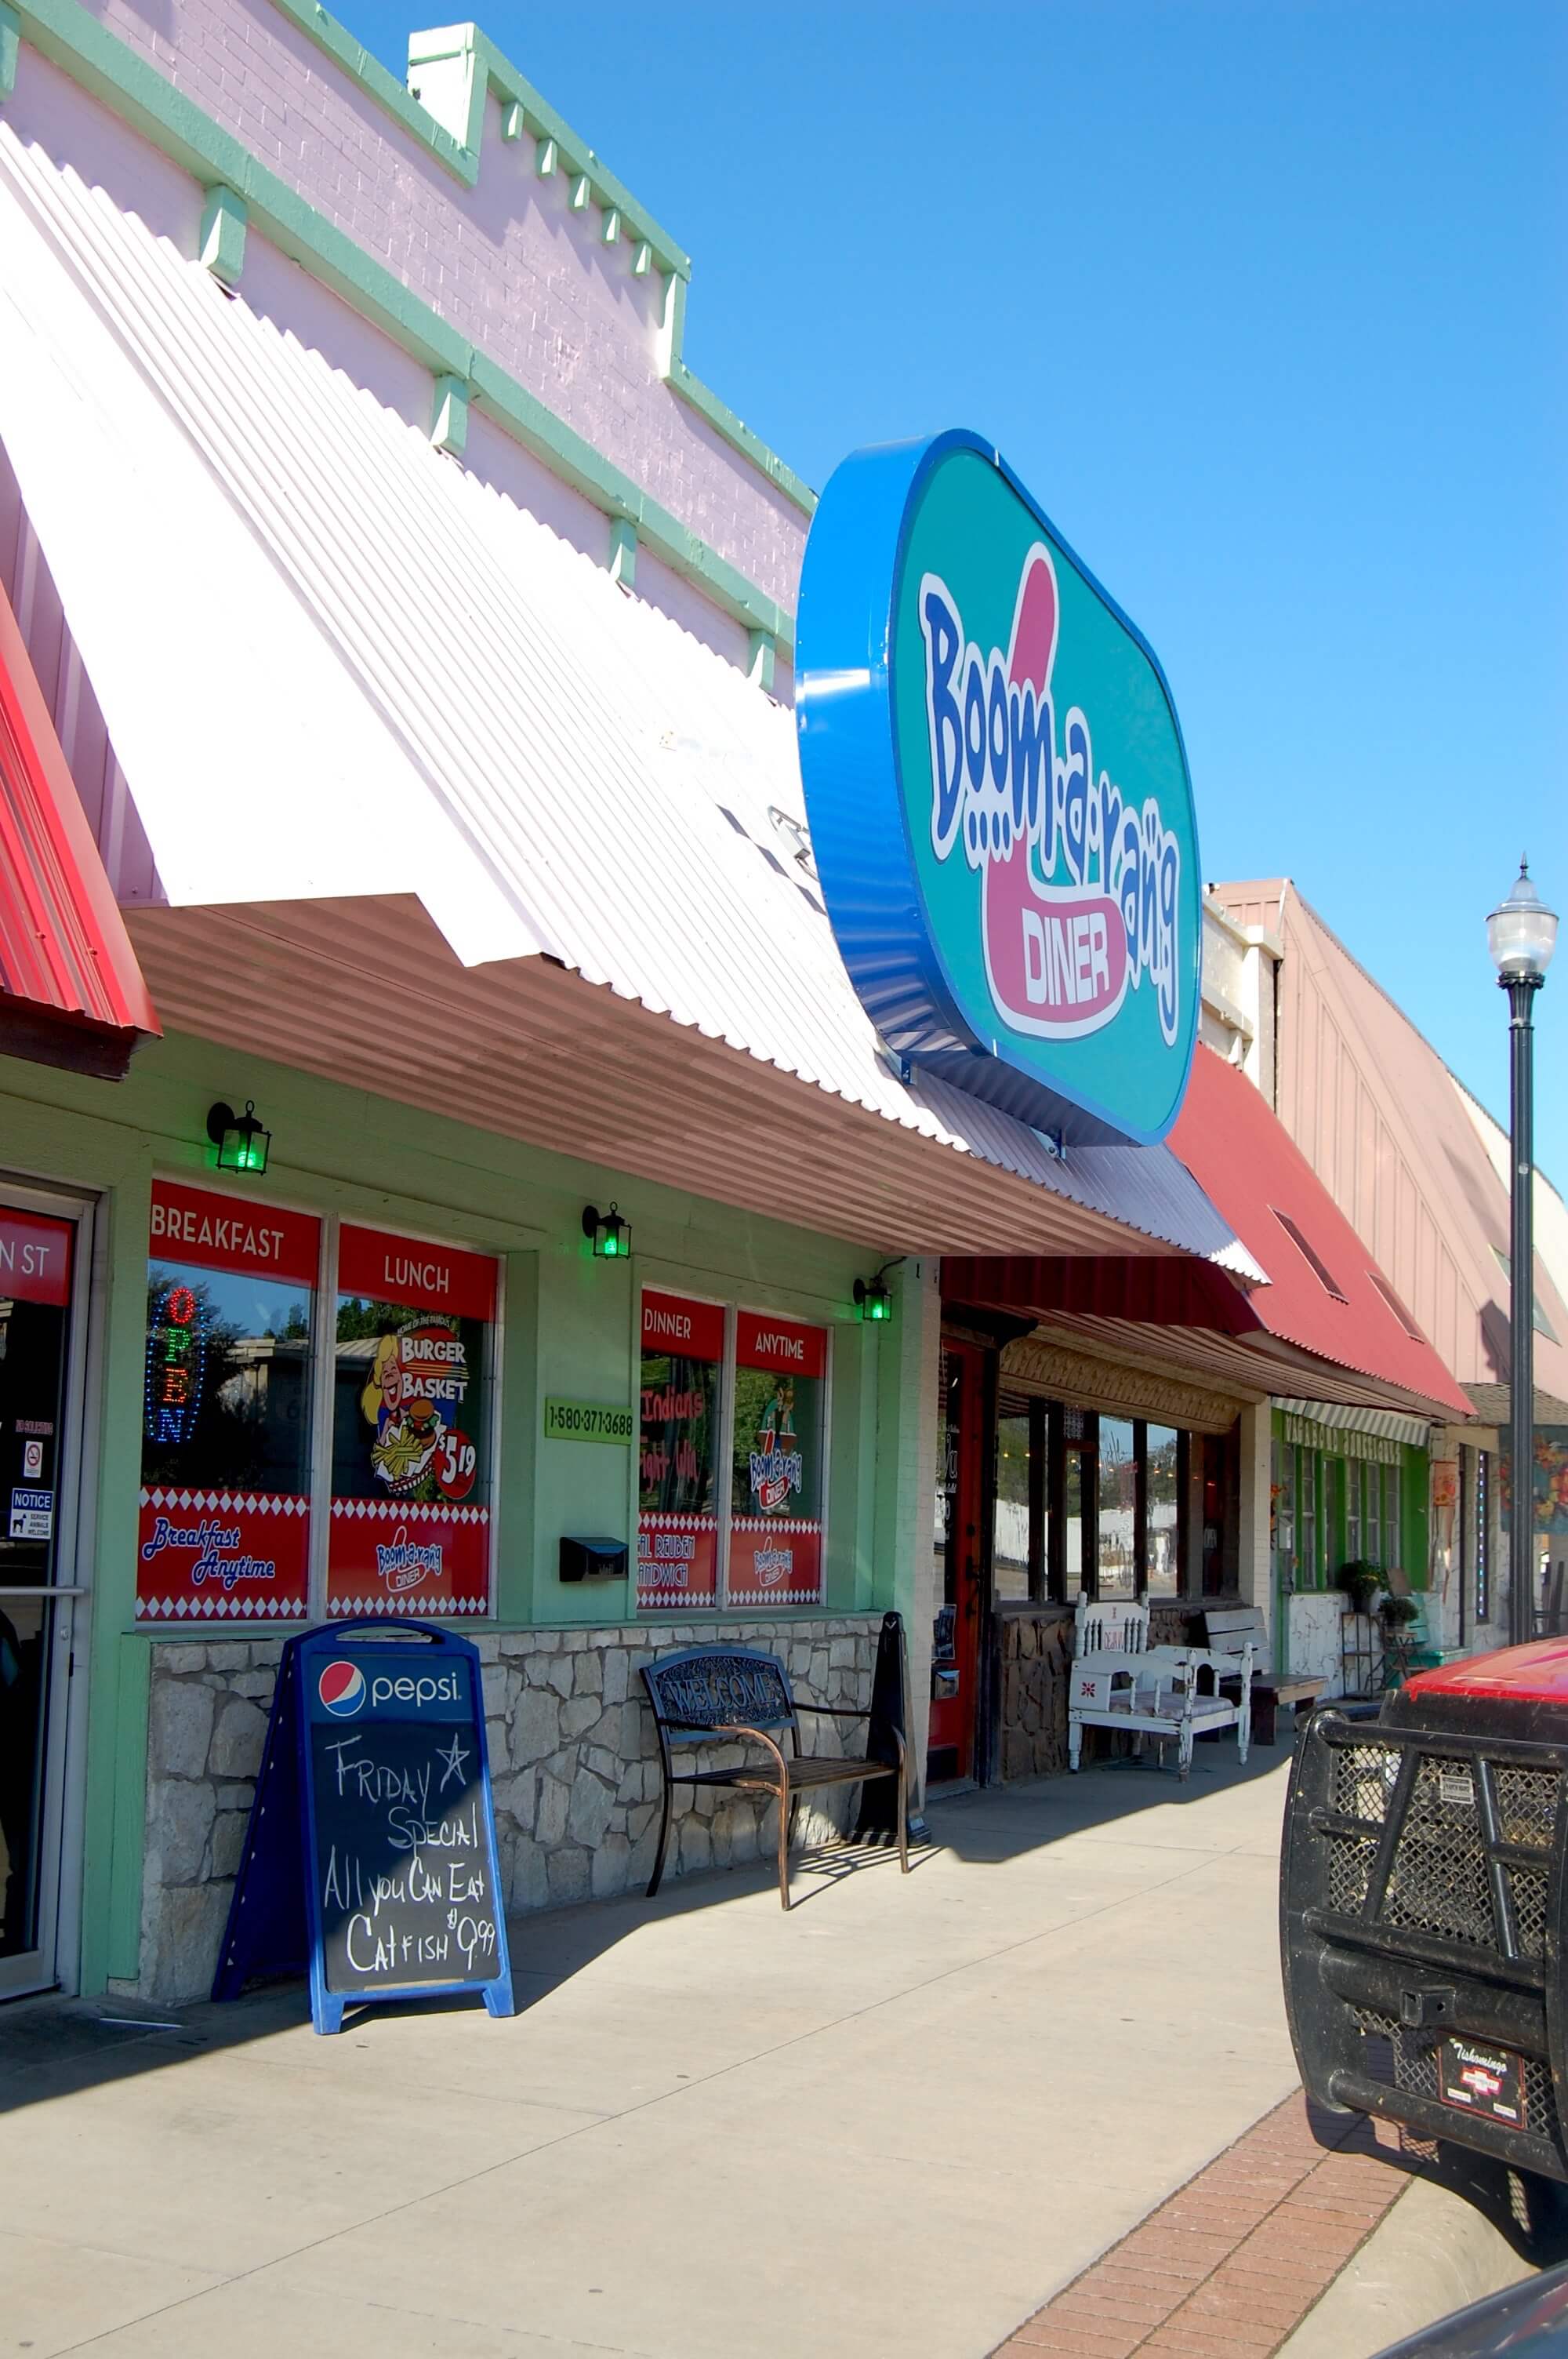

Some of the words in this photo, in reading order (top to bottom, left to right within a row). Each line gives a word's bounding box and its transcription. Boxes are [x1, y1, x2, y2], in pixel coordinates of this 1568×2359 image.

[1021, 907, 1110, 1006] DINER
[151, 1203, 285, 1259] BREAKFAST
[21, 1244, 50, 1277] ST
[384, 1255, 449, 1294] LUNCH
[644, 1307, 691, 1339] DINNER
[401, 1336, 466, 1364] BURGER
[755, 1332, 804, 1361] ANYTIME
[158, 1286, 195, 1444] OPEN
[401, 1372, 468, 1403] BASKET
[14, 1492, 51, 1508] NOTICE
[142, 1517, 241, 1560] Breakfast
[655, 1534, 695, 1560] REUBEN
[192, 1549, 276, 1590] Anytime
[396, 1568, 421, 1588] DINER
[637, 1562, 689, 1588] ANDWICH
[372, 1672, 459, 1707] pepsi
[665, 1672, 775, 1714] WELCOME
[324, 1844, 364, 1910] All
[1453, 2041, 1508, 2076] Tishomingo
